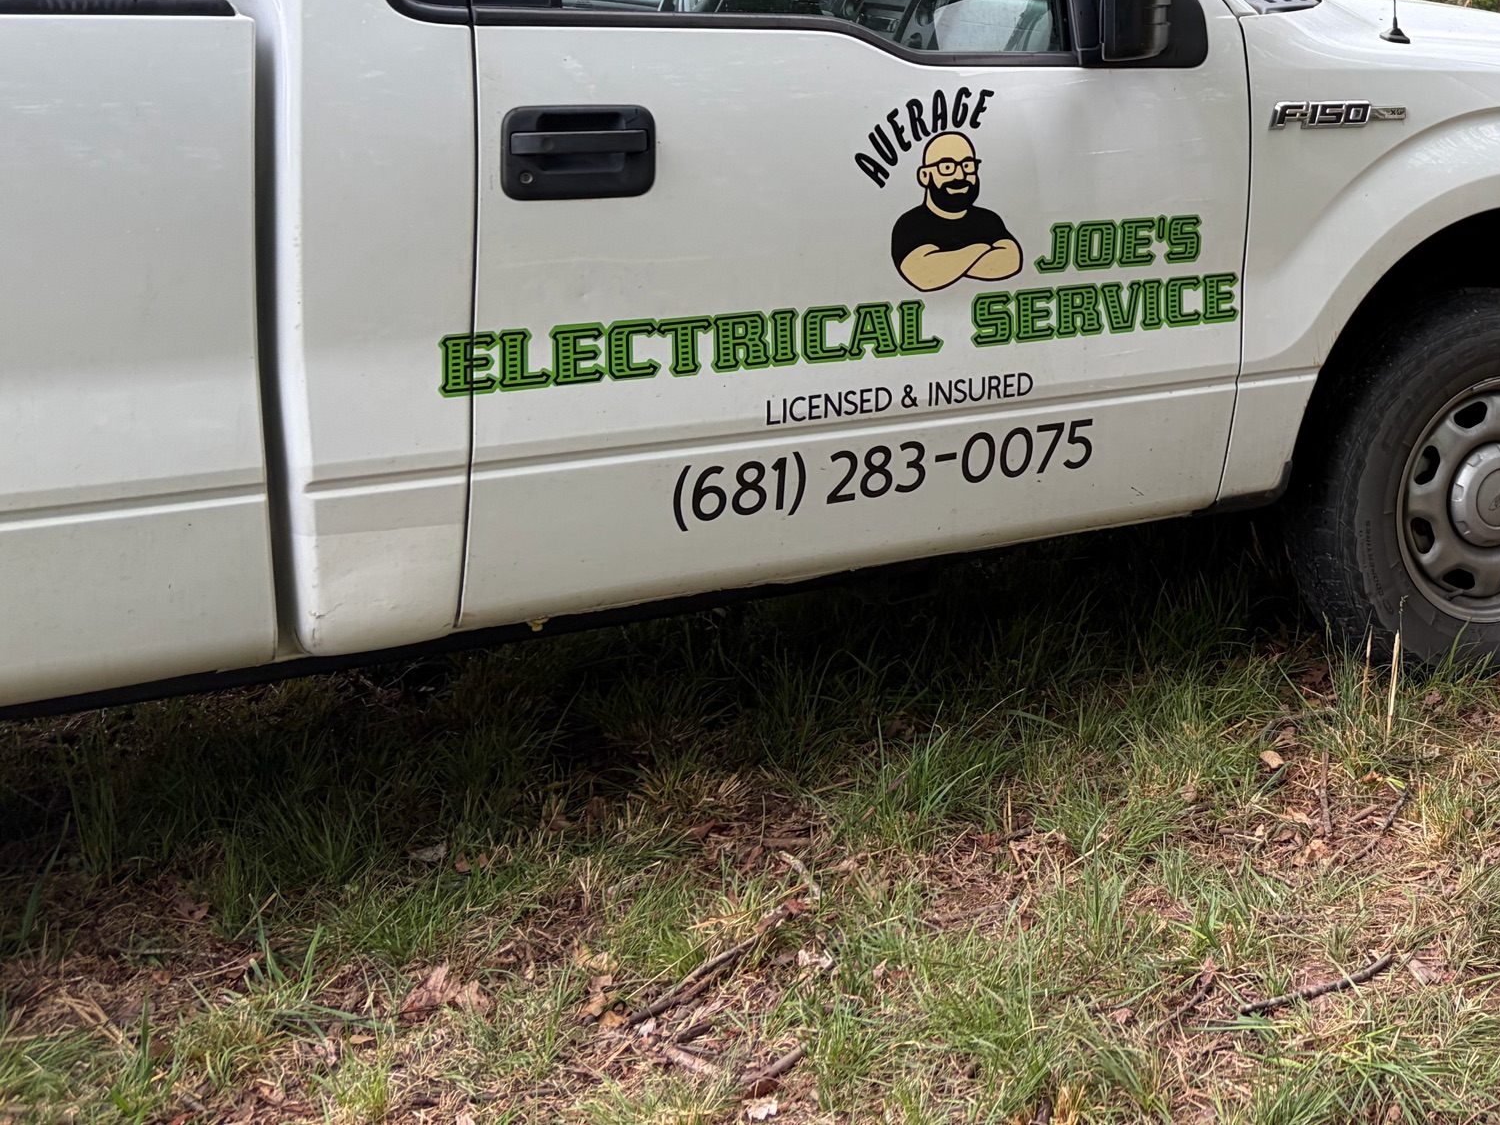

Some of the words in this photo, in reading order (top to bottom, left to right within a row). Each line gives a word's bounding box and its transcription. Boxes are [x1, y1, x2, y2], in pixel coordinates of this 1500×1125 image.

[854, 86, 995, 189] AVERAGE
[1268, 99, 1372, 130] F-150
[1033, 213, 1203, 275] JOE'S
[438, 299, 943, 398] ELECTRICAL
[972, 271, 1239, 349] SERVICE
[766, 386, 893, 426] LICENSED
[900, 384, 919, 409] &
[928, 372, 1034, 407] INSURED
[672, 451, 807, 532] (681)
[826, 418, 1094, 505] 283-0075
